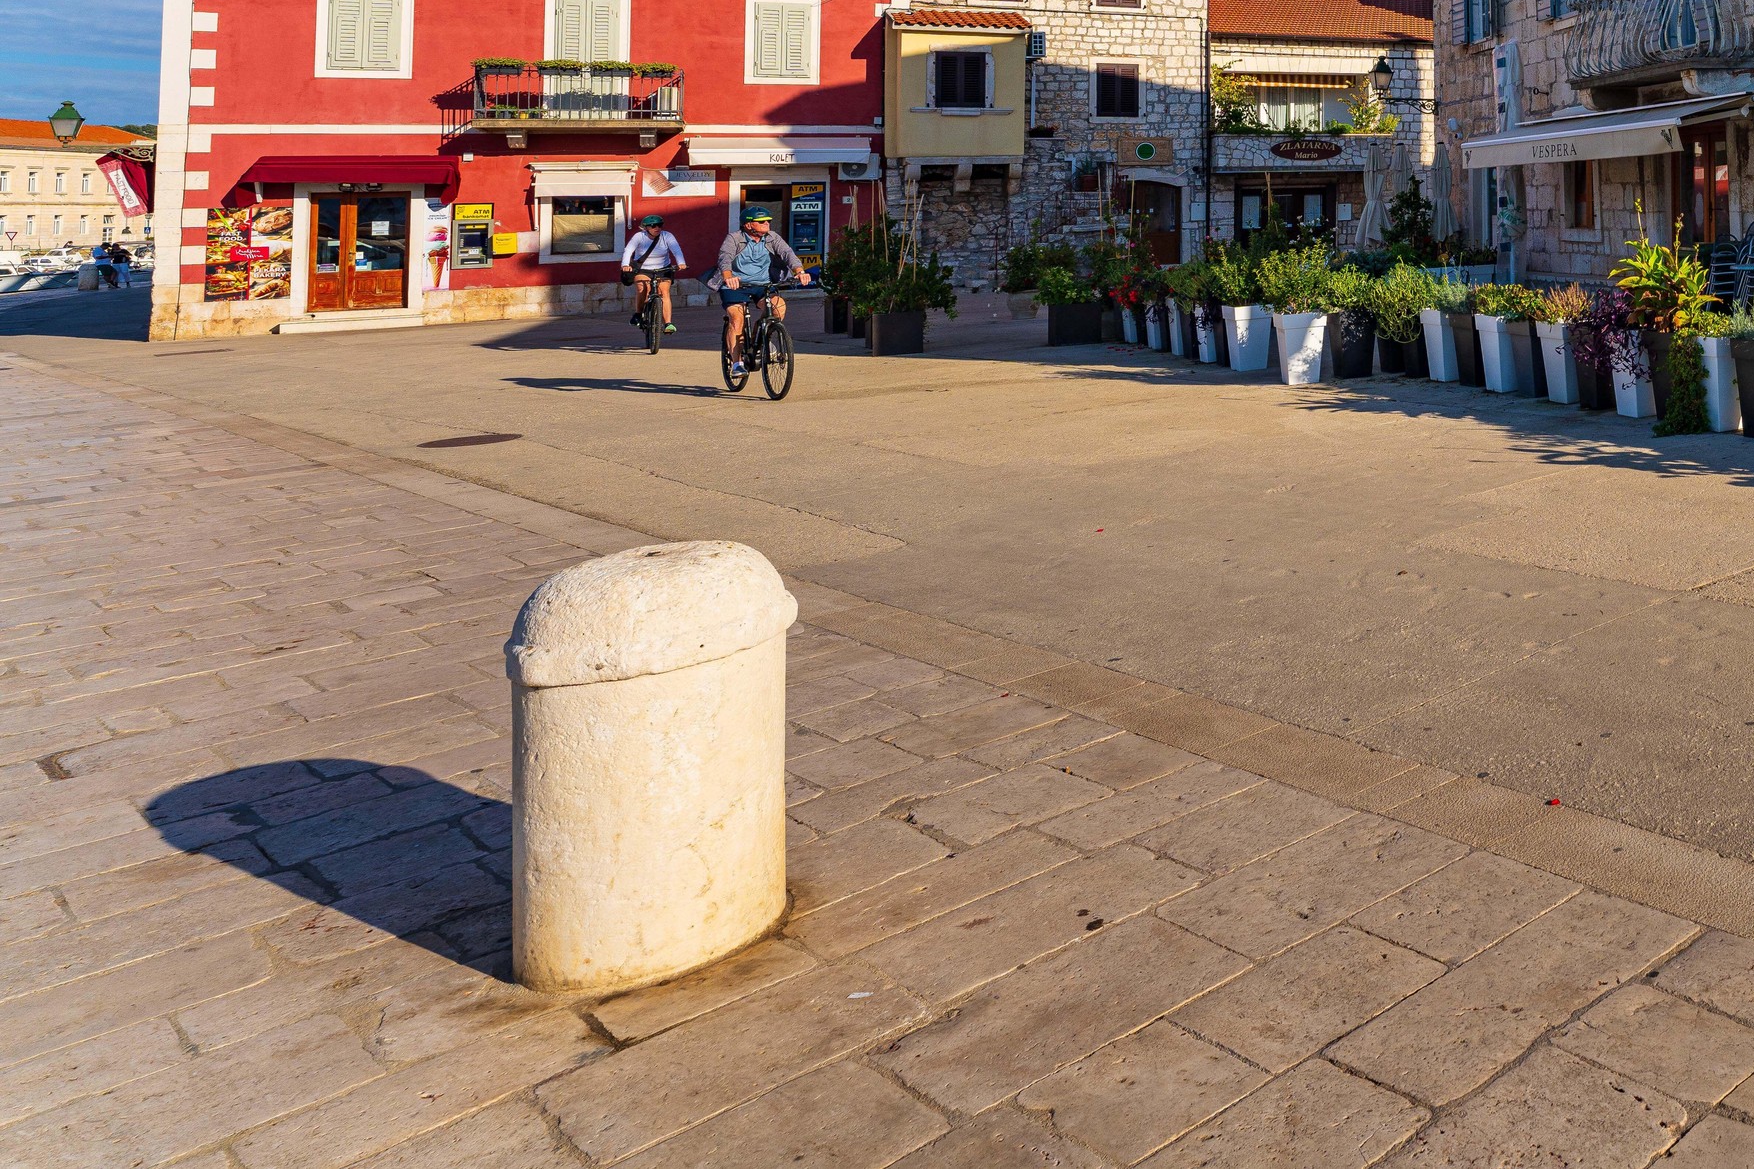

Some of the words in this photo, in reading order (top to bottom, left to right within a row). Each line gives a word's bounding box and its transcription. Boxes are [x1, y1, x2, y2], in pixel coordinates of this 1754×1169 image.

[1279, 141, 1337, 152] ZLATARNA
[1532, 142, 1578, 159] VESPERA
[769, 153, 795, 163] KOLET
[1294, 151, 1318, 159] Mario
[794, 202, 819, 210] ATM
[800, 256, 818, 264] TM
